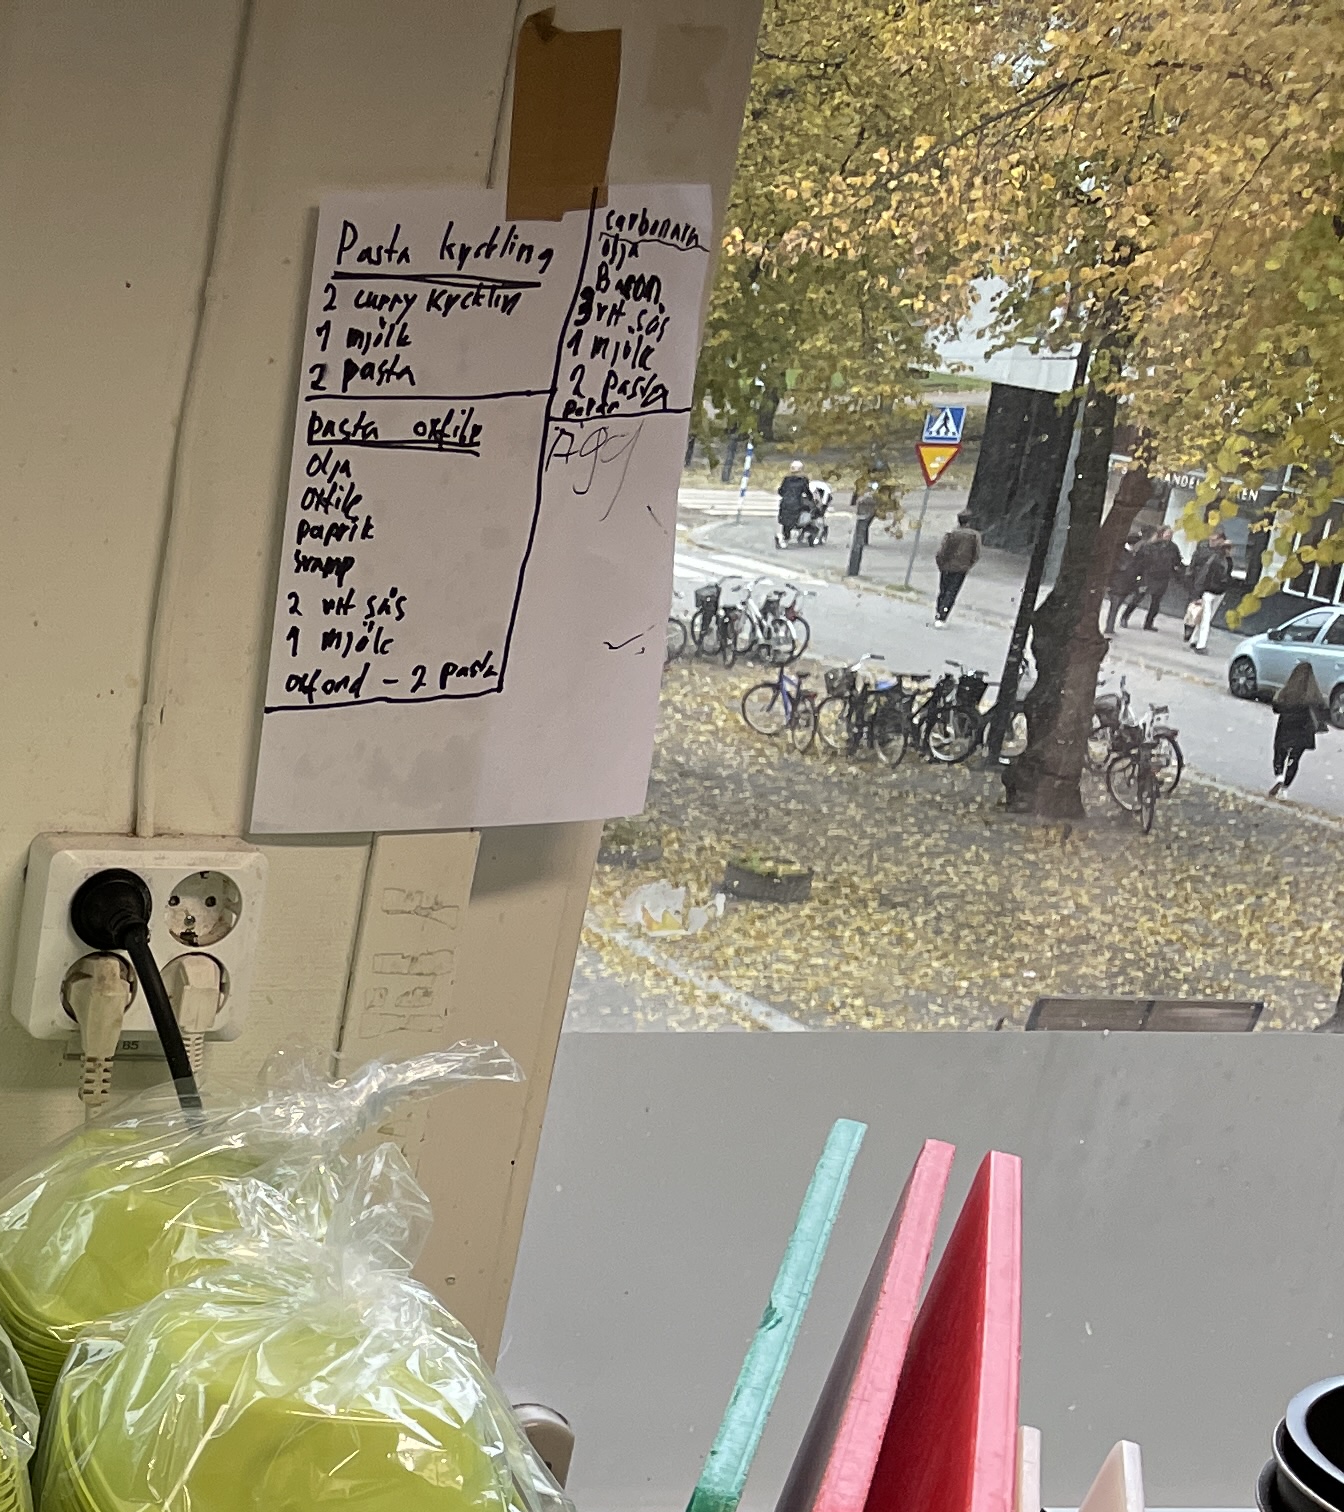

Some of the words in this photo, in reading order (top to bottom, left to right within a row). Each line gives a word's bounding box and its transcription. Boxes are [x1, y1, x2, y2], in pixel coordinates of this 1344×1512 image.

[323, 282, 337, 312] 2
[309, 362, 328, 391] 2
[569, 363, 586, 399] 2
[287, 591, 303, 616] 2
[286, 625, 300, 657] 1
[410, 664, 427, 693] 2
